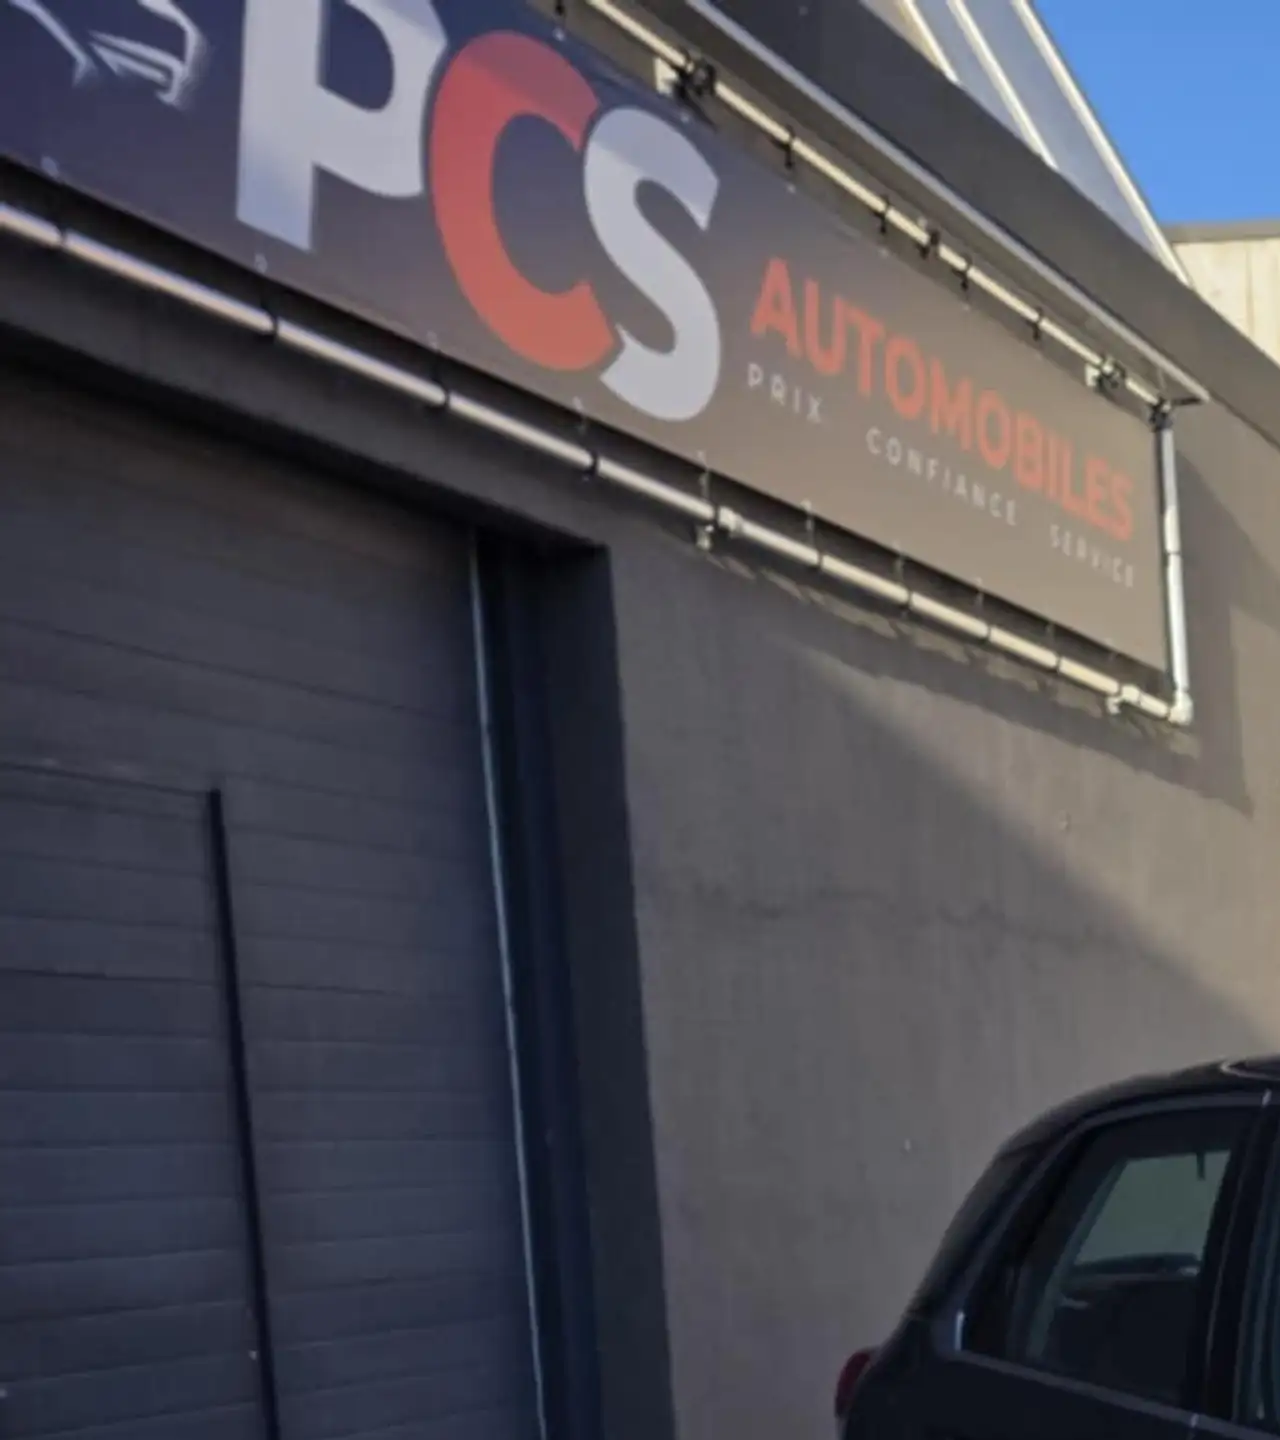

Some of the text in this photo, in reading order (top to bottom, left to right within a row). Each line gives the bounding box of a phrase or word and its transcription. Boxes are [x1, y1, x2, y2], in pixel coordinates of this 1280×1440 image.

[236, 0, 721, 421] PCS
[747, 362, 1135, 588] PRIX CONFIANCE SERVICE
[751, 257, 1134, 541] AUTOMOBILES
